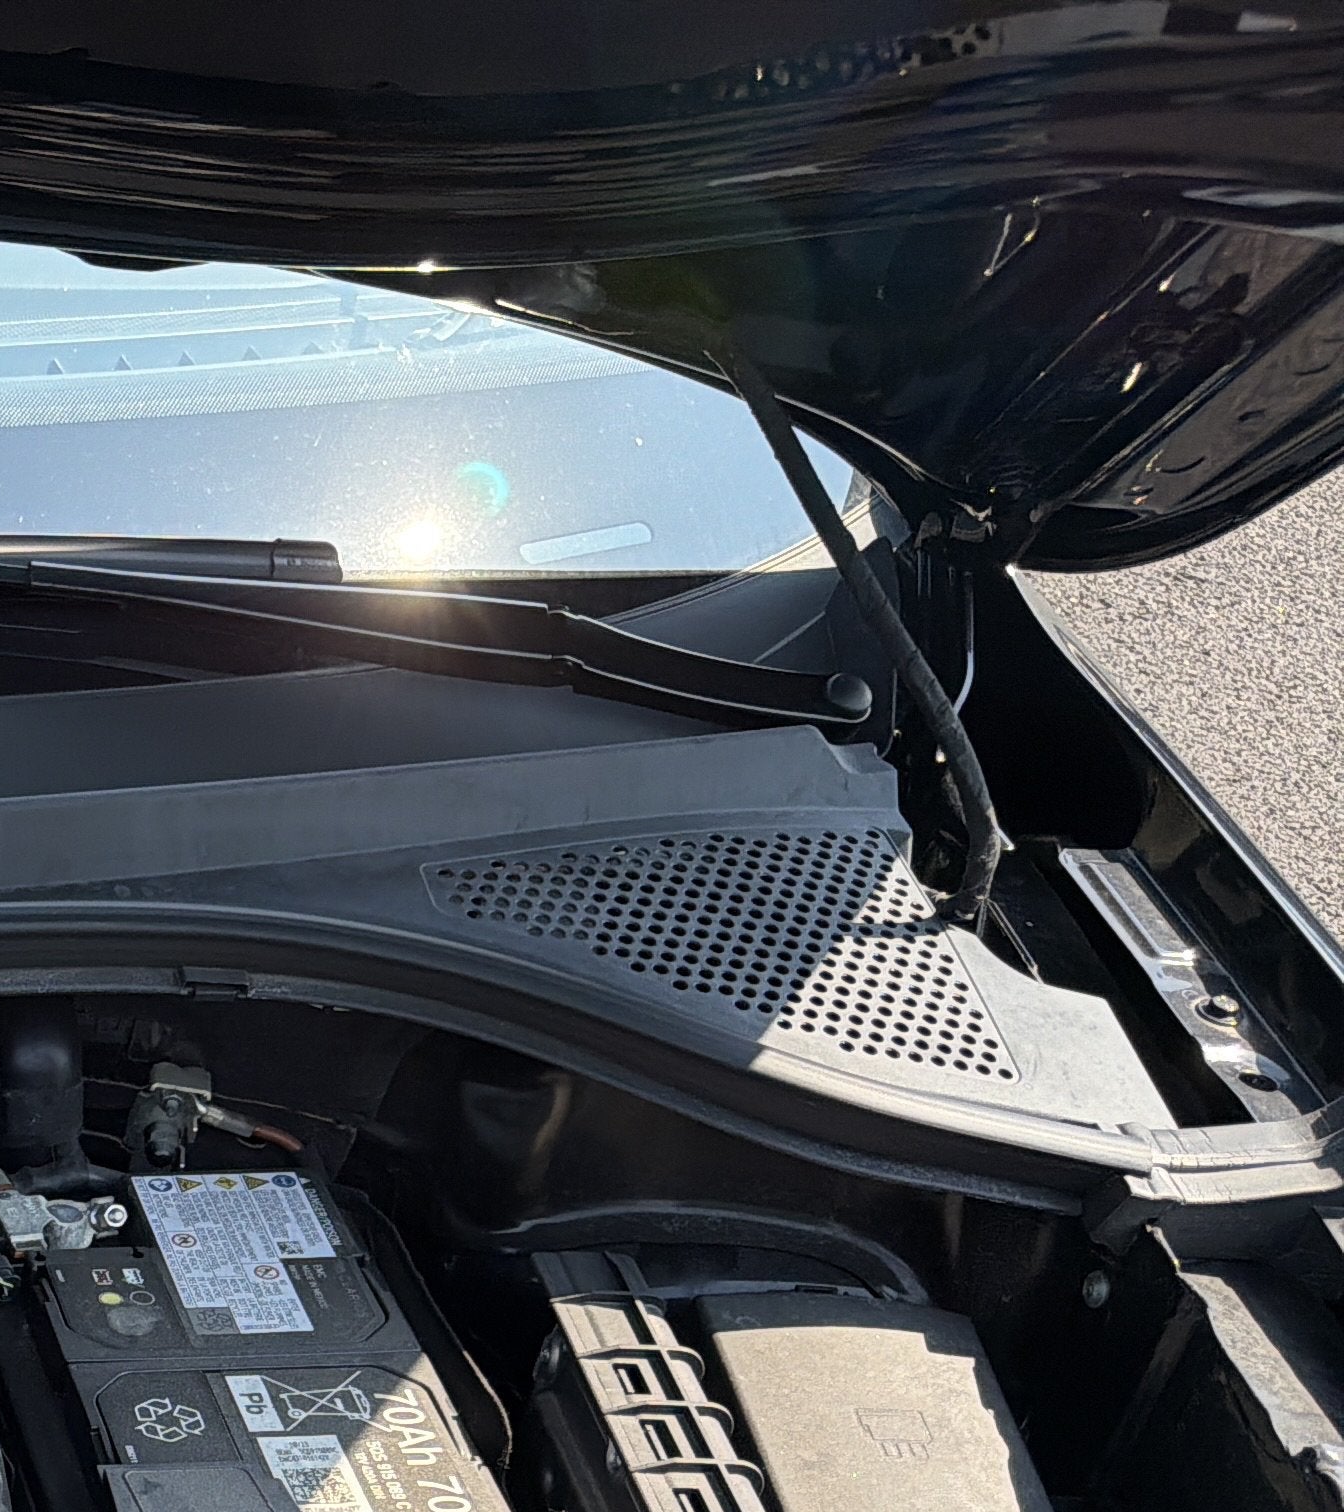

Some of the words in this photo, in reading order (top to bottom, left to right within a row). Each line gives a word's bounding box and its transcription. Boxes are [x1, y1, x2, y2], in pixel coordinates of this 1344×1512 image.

[239, 1392, 263, 1415] Pb
[374, 1388, 443, 1466] 70Ah
[394, 1501, 412, 1509] C
